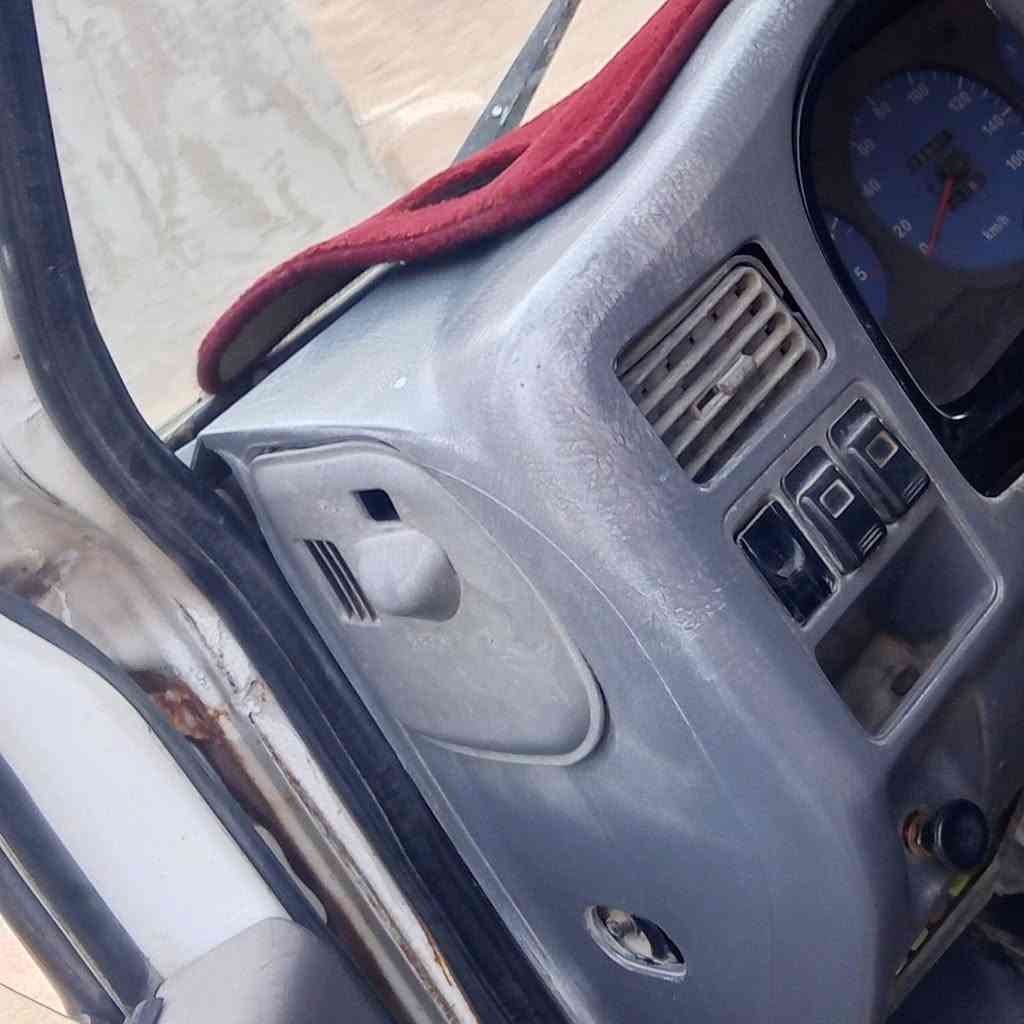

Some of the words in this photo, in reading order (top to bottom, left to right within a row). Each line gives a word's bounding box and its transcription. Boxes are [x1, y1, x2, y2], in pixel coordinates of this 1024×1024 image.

[981, 113, 1005, 136] 140
[892, 219, 912, 240] 20
[852, 266, 868, 282] 5
